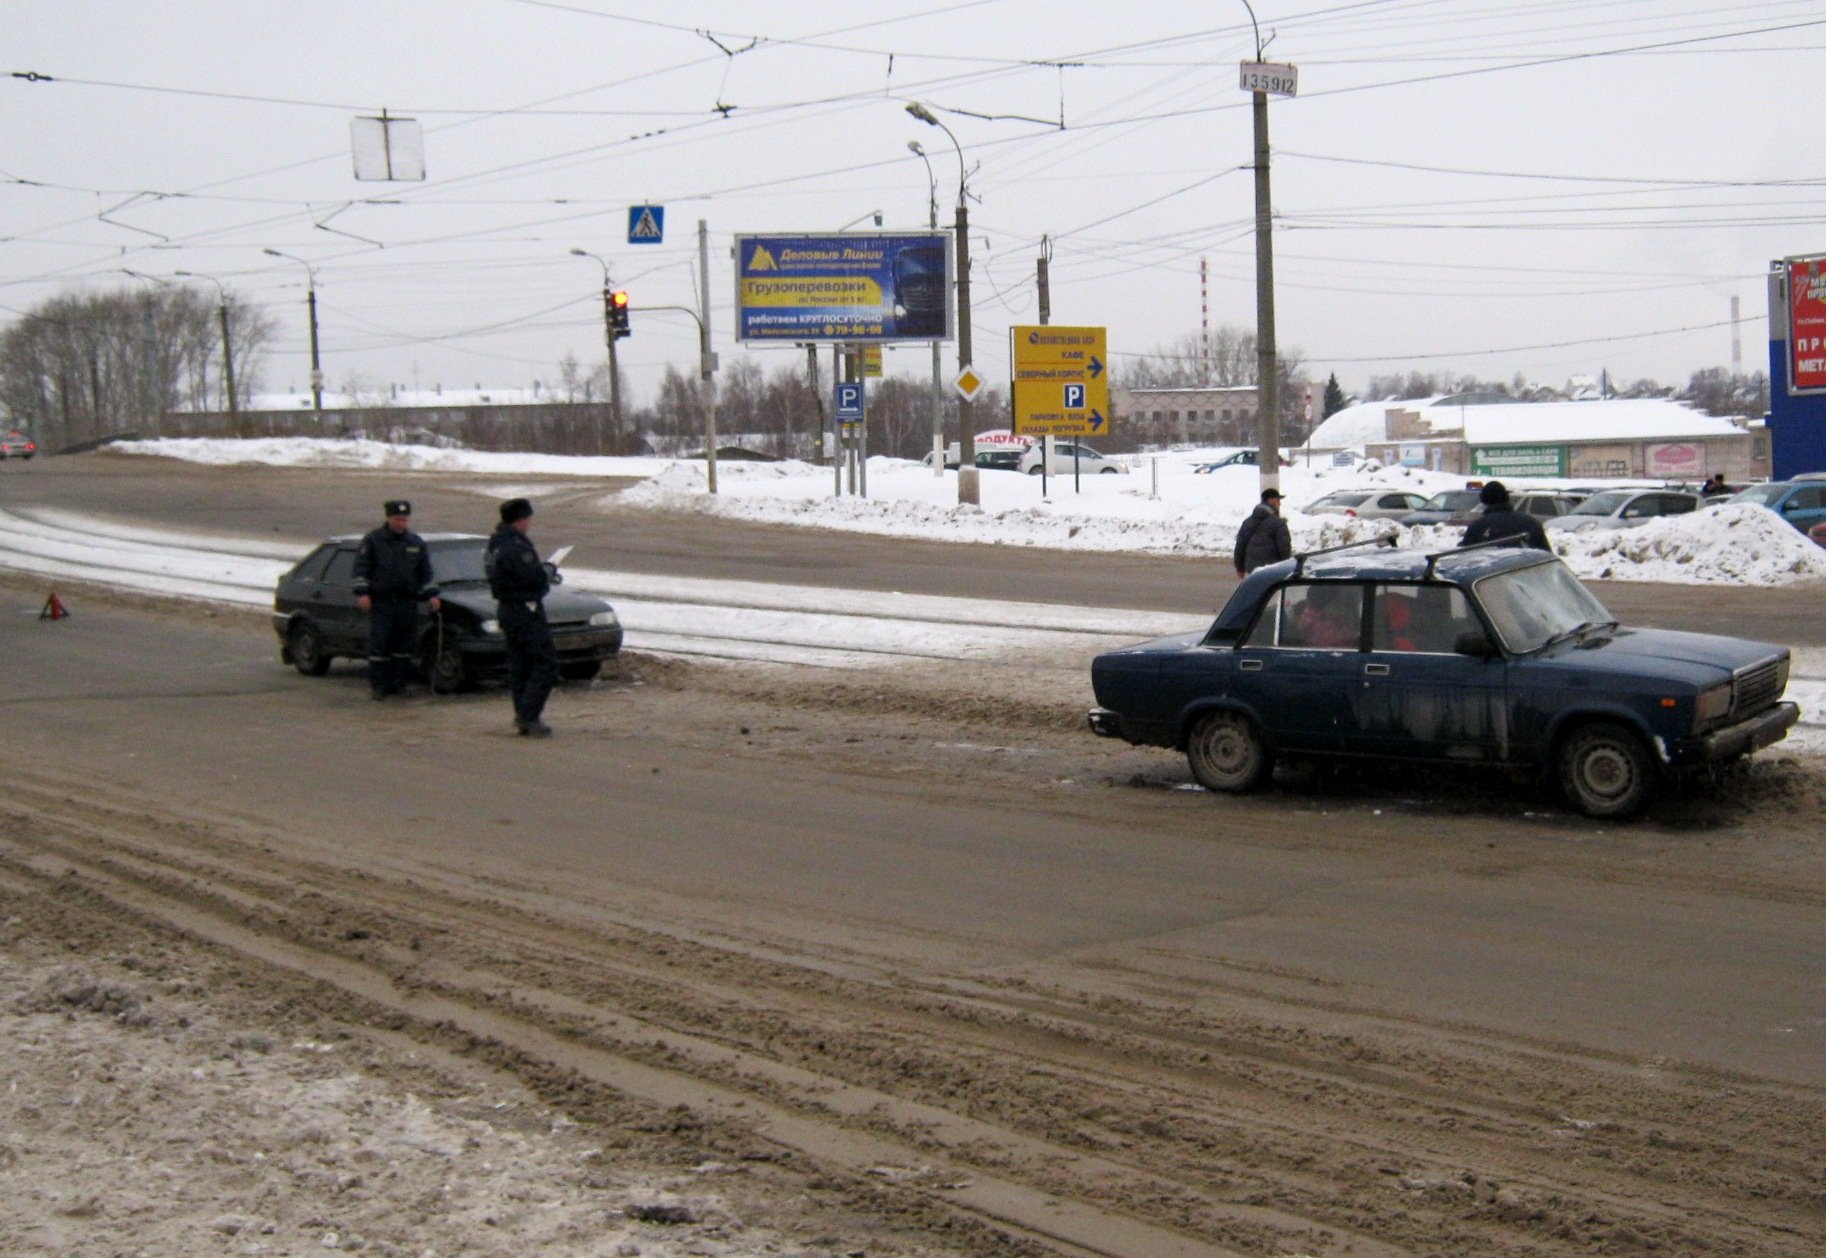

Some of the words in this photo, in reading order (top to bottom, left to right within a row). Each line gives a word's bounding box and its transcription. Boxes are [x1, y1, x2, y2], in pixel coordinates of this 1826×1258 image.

[1243, 73, 1294, 94] 135912
[780, 249, 839, 262] Деловые
[843, 249, 883, 260] Линии
[748, 281, 866, 296] Грузоперевозки
[748, 315, 798, 325] работаем
[799, 314, 883, 323] КРУГЛОСУТОЧНО
